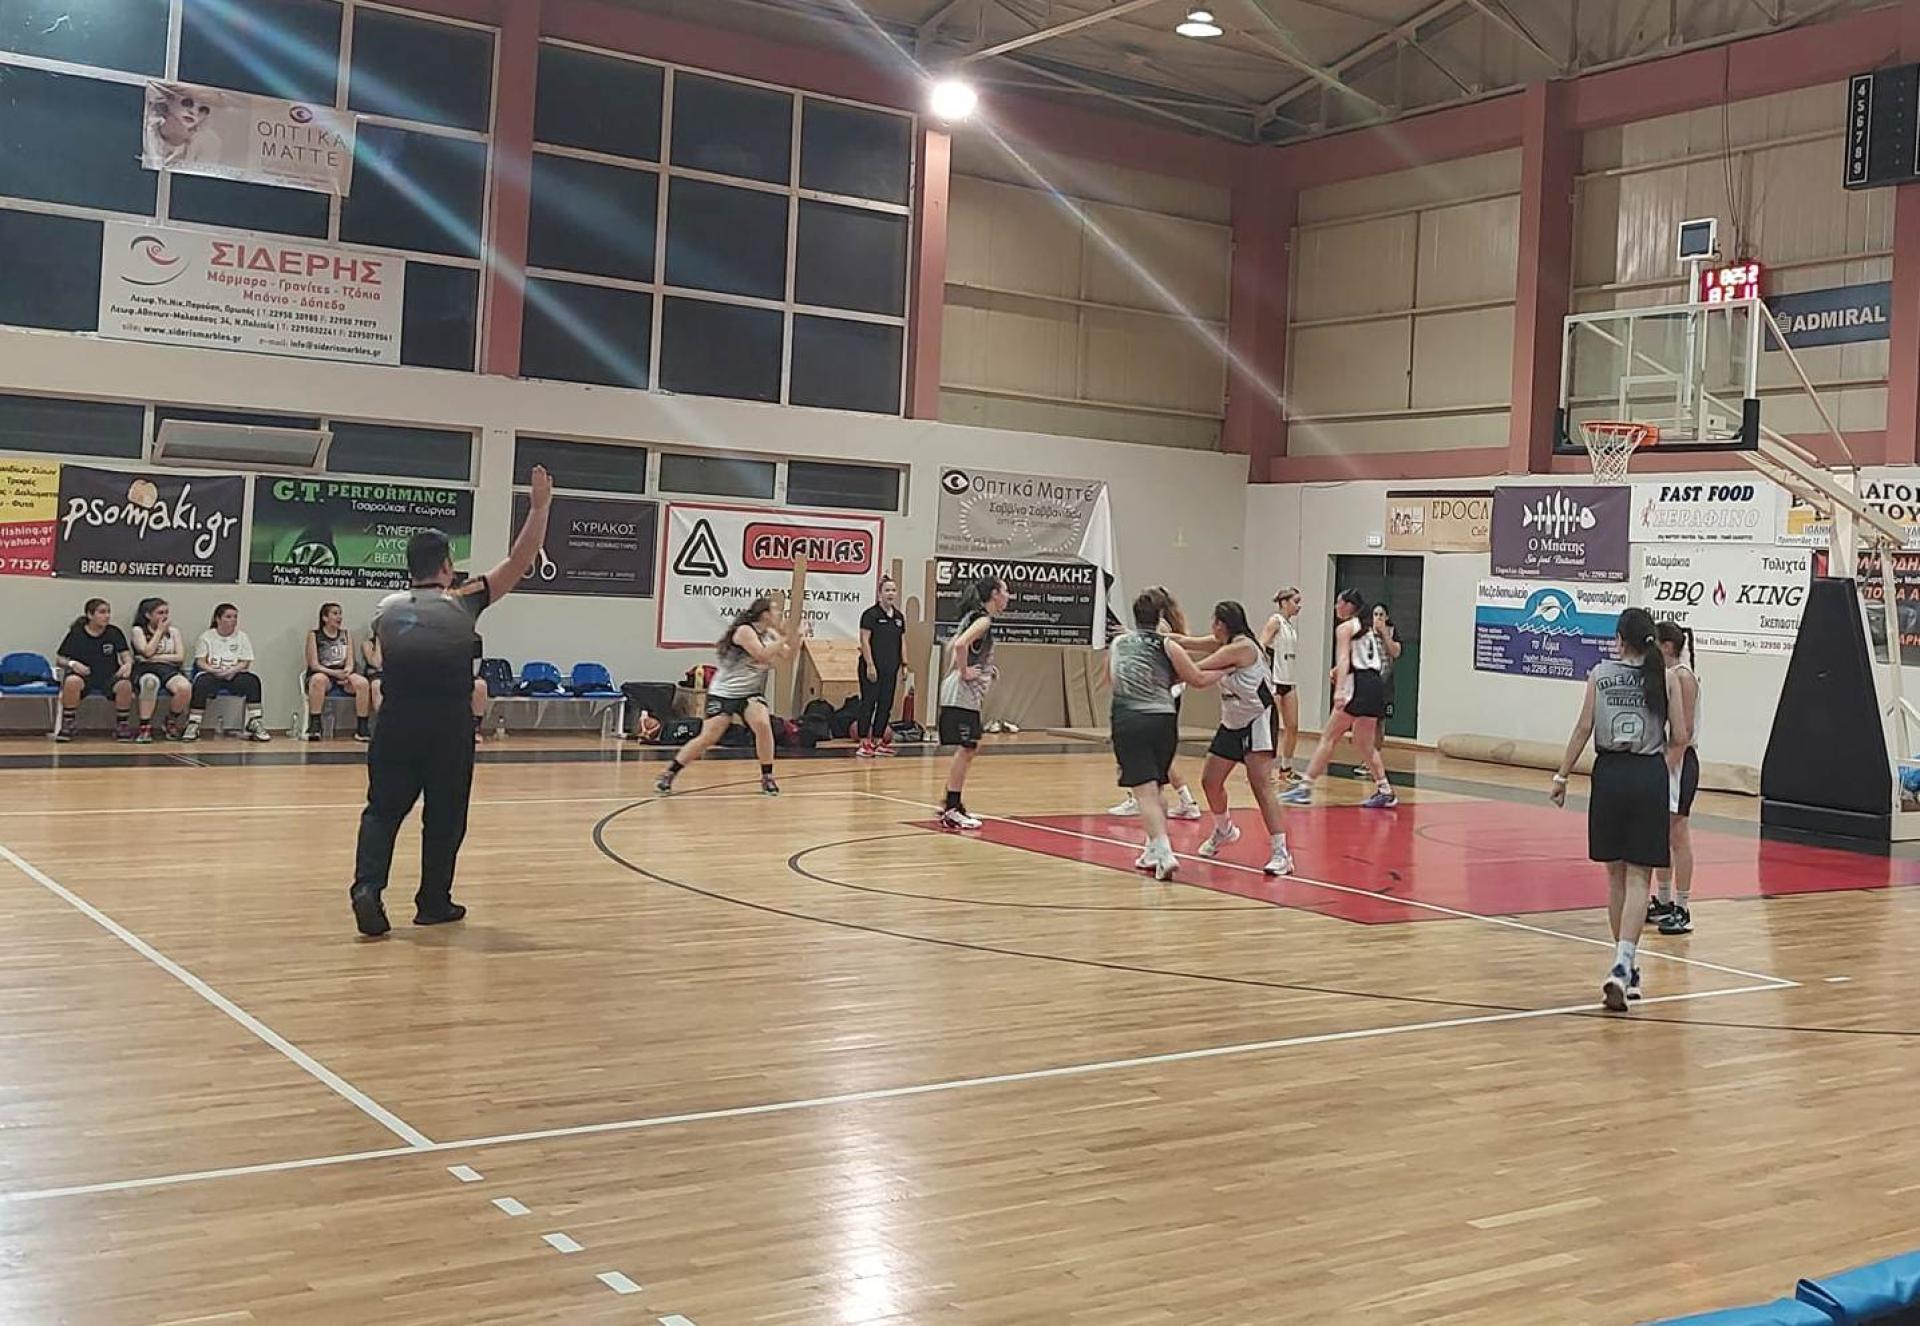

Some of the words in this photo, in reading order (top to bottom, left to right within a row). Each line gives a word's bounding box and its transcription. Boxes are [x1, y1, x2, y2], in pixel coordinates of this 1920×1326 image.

[1857, 83, 1866, 96] 4
[1856, 99, 1865, 112] 5
[1856, 115, 1865, 127] 6
[1855, 130, 1864, 144] 7
[1855, 146, 1862, 159] 8
[1853, 161, 1862, 174] 9
[210, 241, 383, 285] ΣΙΔΕΡΗΣ
[1792, 304, 1887, 333] ADMIRAL
[327, 483, 458, 504] PERFORMANCE
[972, 475, 1034, 497] Οπτικά
[1037, 481, 1095, 502] Ματτέ
[1659, 486, 1703, 502] FAST
[1707, 485, 1755, 502] FOOD
[572, 521, 637, 535] ΚΥΡΙΑΚΟΣ
[753, 533, 866, 564] ANANIAS
[1528, 538, 1538, 551] Ο
[1540, 539, 1585, 556] Μπάτης
[10, 558, 50, 571] 71376
[81, 560, 117, 574] BREAD
[128, 562, 166, 575] SWEET
[175, 564, 214, 578] COFFEE
[957, 562, 1093, 584] ΣΚΟΥΛΟΥΔΑΚΗΣ
[683, 584, 751, 598] ΕΜΠΟΡΙΚΗ
[1654, 581, 1705, 606] BBQ
[1736, 584, 1805, 606] KING
